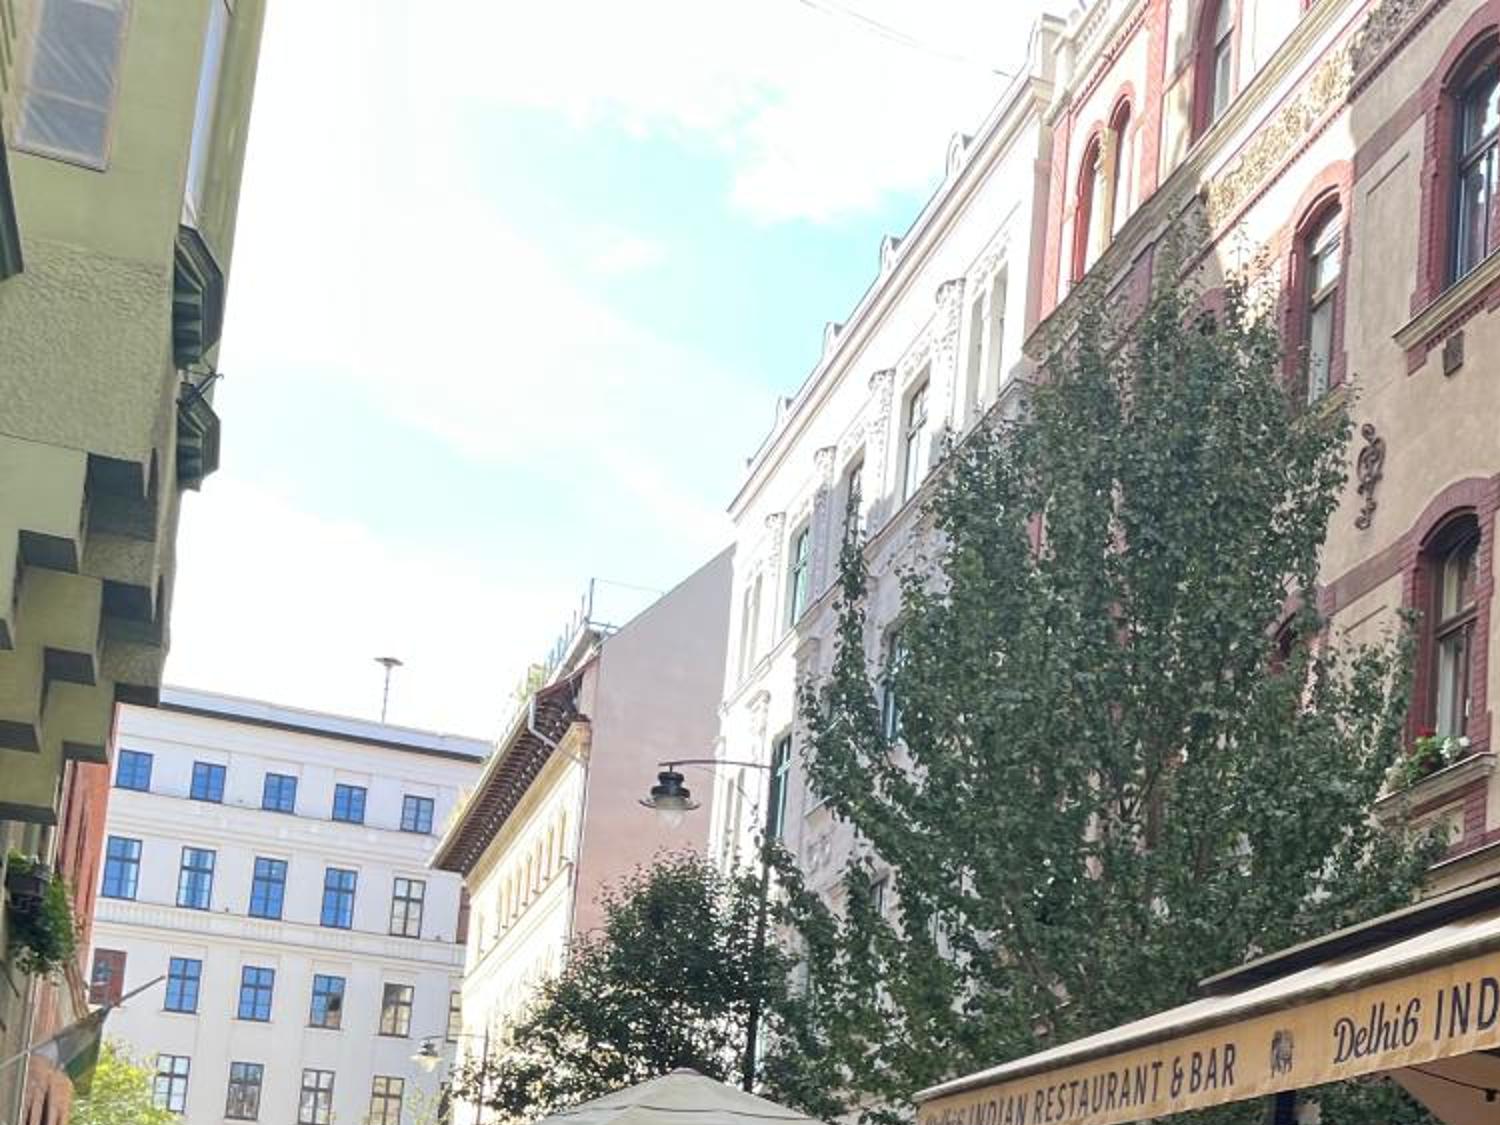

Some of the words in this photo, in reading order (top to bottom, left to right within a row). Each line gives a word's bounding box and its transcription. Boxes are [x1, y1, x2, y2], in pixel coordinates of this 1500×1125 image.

[1333, 998, 1420, 1064] Delhi6
[1034, 1061, 1162, 1124] RESTAURANT
[1171, 1063, 1183, 1099] &
[1190, 1044, 1236, 1092] BAR
